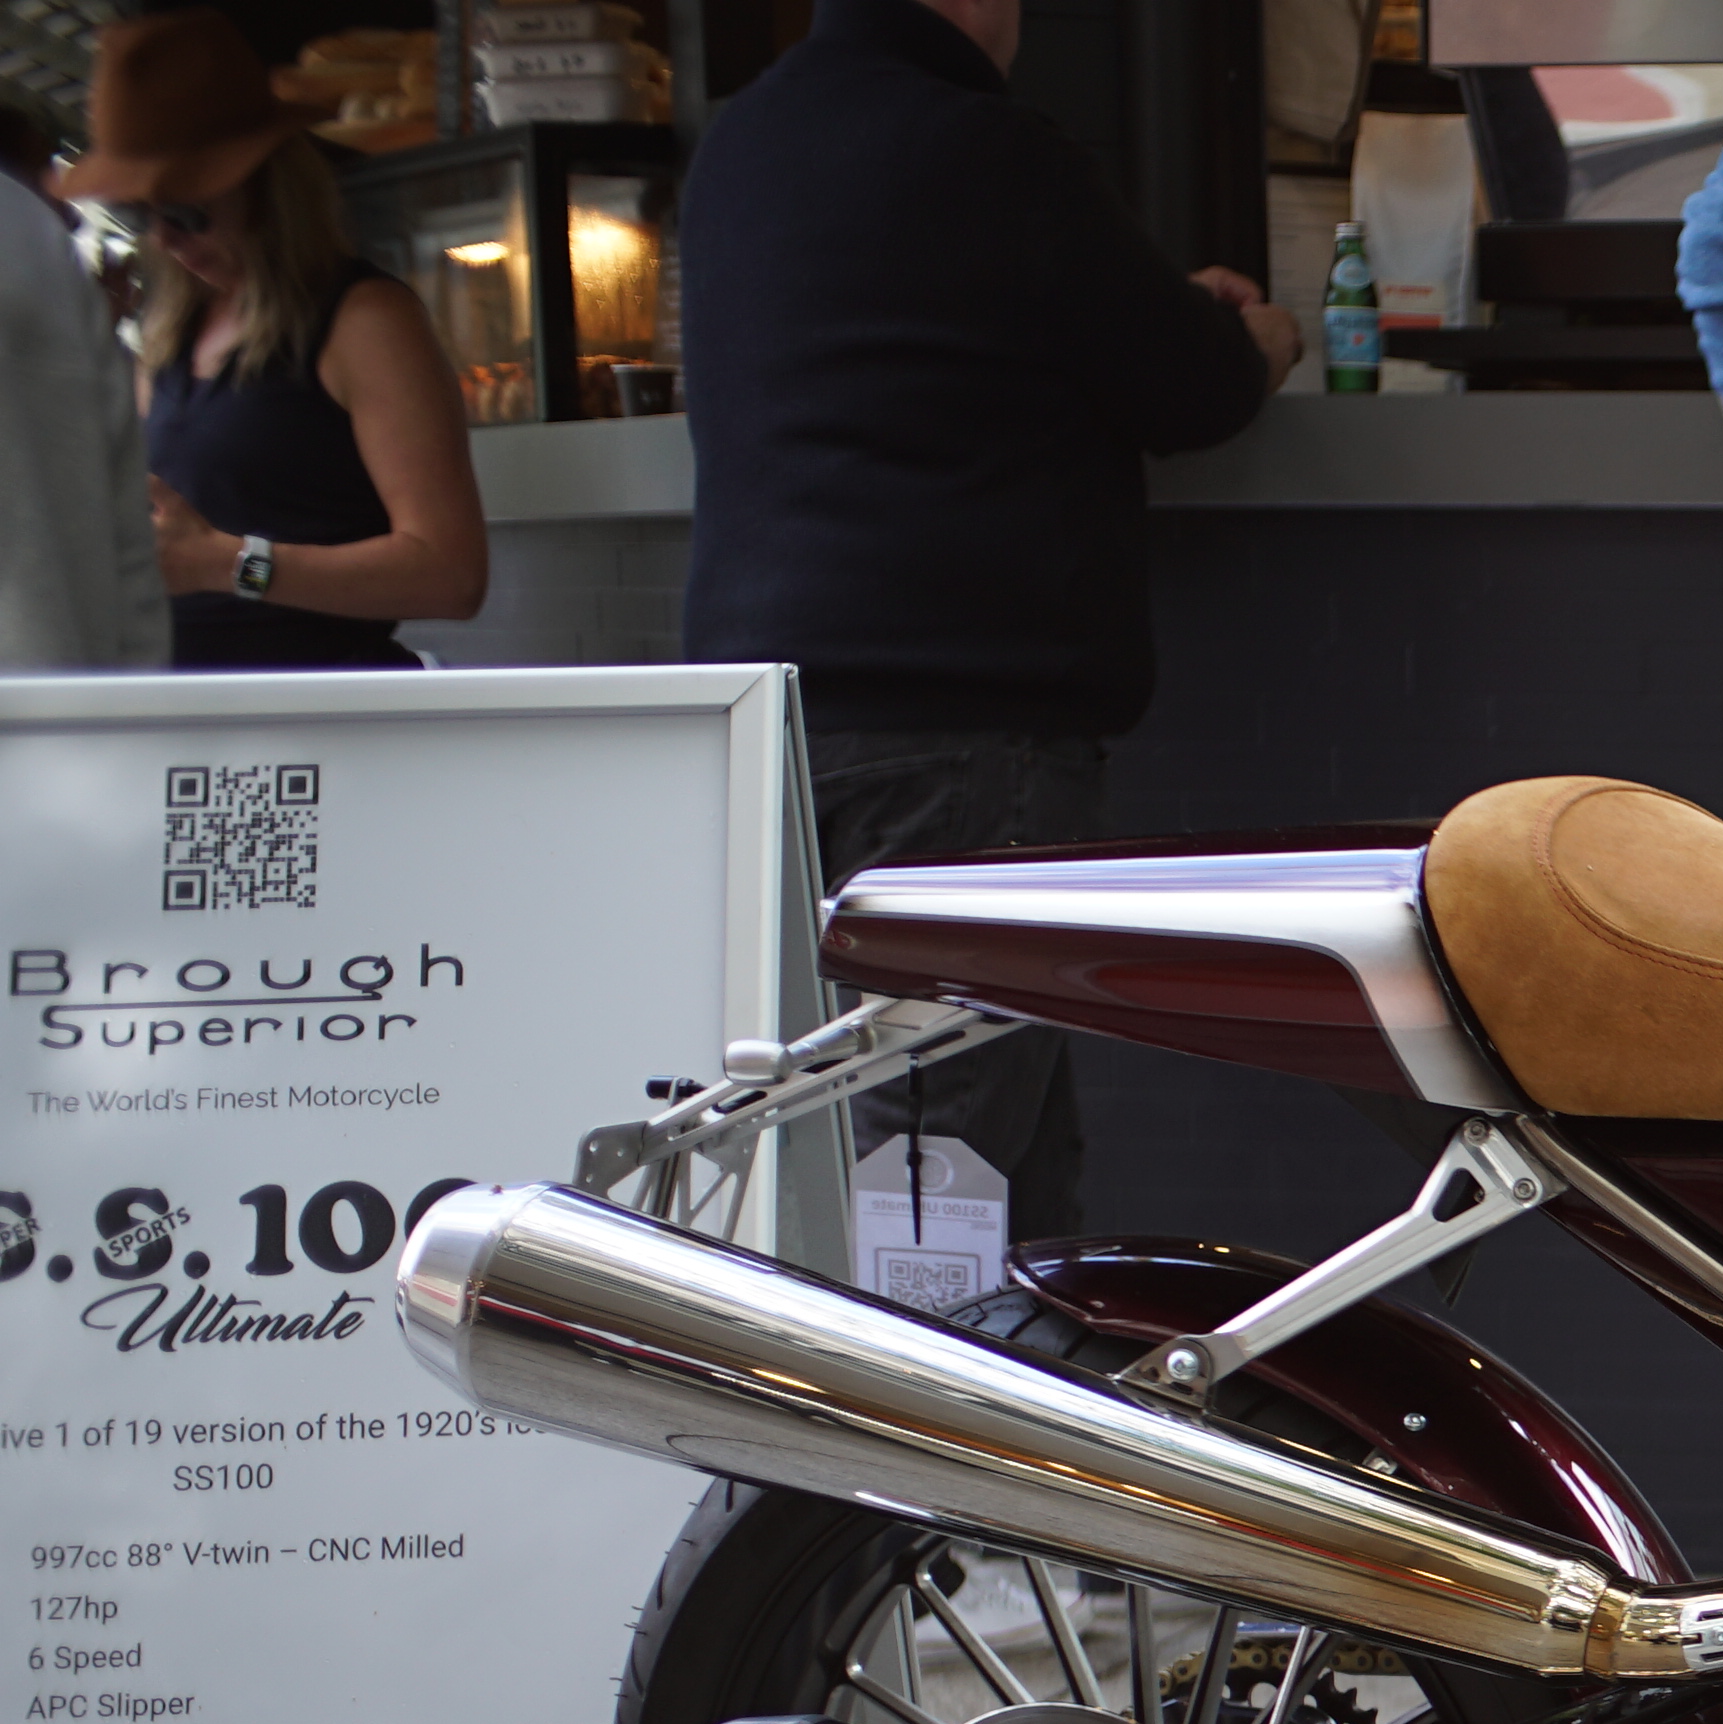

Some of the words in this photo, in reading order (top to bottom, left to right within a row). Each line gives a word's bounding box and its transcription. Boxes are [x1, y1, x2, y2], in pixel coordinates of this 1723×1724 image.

[10, 943, 464, 1000] Brough
[39, 1000, 418, 1056] Superior
[28, 1090, 81, 1114] The
[87, 1086, 189, 1113] World's
[196, 1085, 279, 1110] Finest
[287, 1081, 441, 1112] Motorcycle
[107, 1206, 192, 1259] SPORTS
[80, 1282, 376, 1353] Ultimate
[56, 1422, 69, 1448] 1
[83, 1418, 117, 1447] of
[125, 1419, 162, 1446] 19
[172, 1416, 286, 1444] version
[295, 1412, 328, 1441] of
[336, 1412, 386, 1440] the
[396, 1410, 496, 1438] 1920's
[172, 1463, 275, 1491] SS100
[31, 1545, 118, 1570] 997cc
[126, 1542, 174, 1567] 88°
[182, 1539, 270, 1566] V-twin
[308, 1537, 371, 1562] CNC
[380, 1532, 465, 1560] Milled
[31, 1595, 119, 1625] 127hp
[28, 1646, 45, 1671] 6
[53, 1642, 143, 1675] Speed
[25, 1694, 89, 1720] APC
[97, 1692, 196, 1722] Slipper
